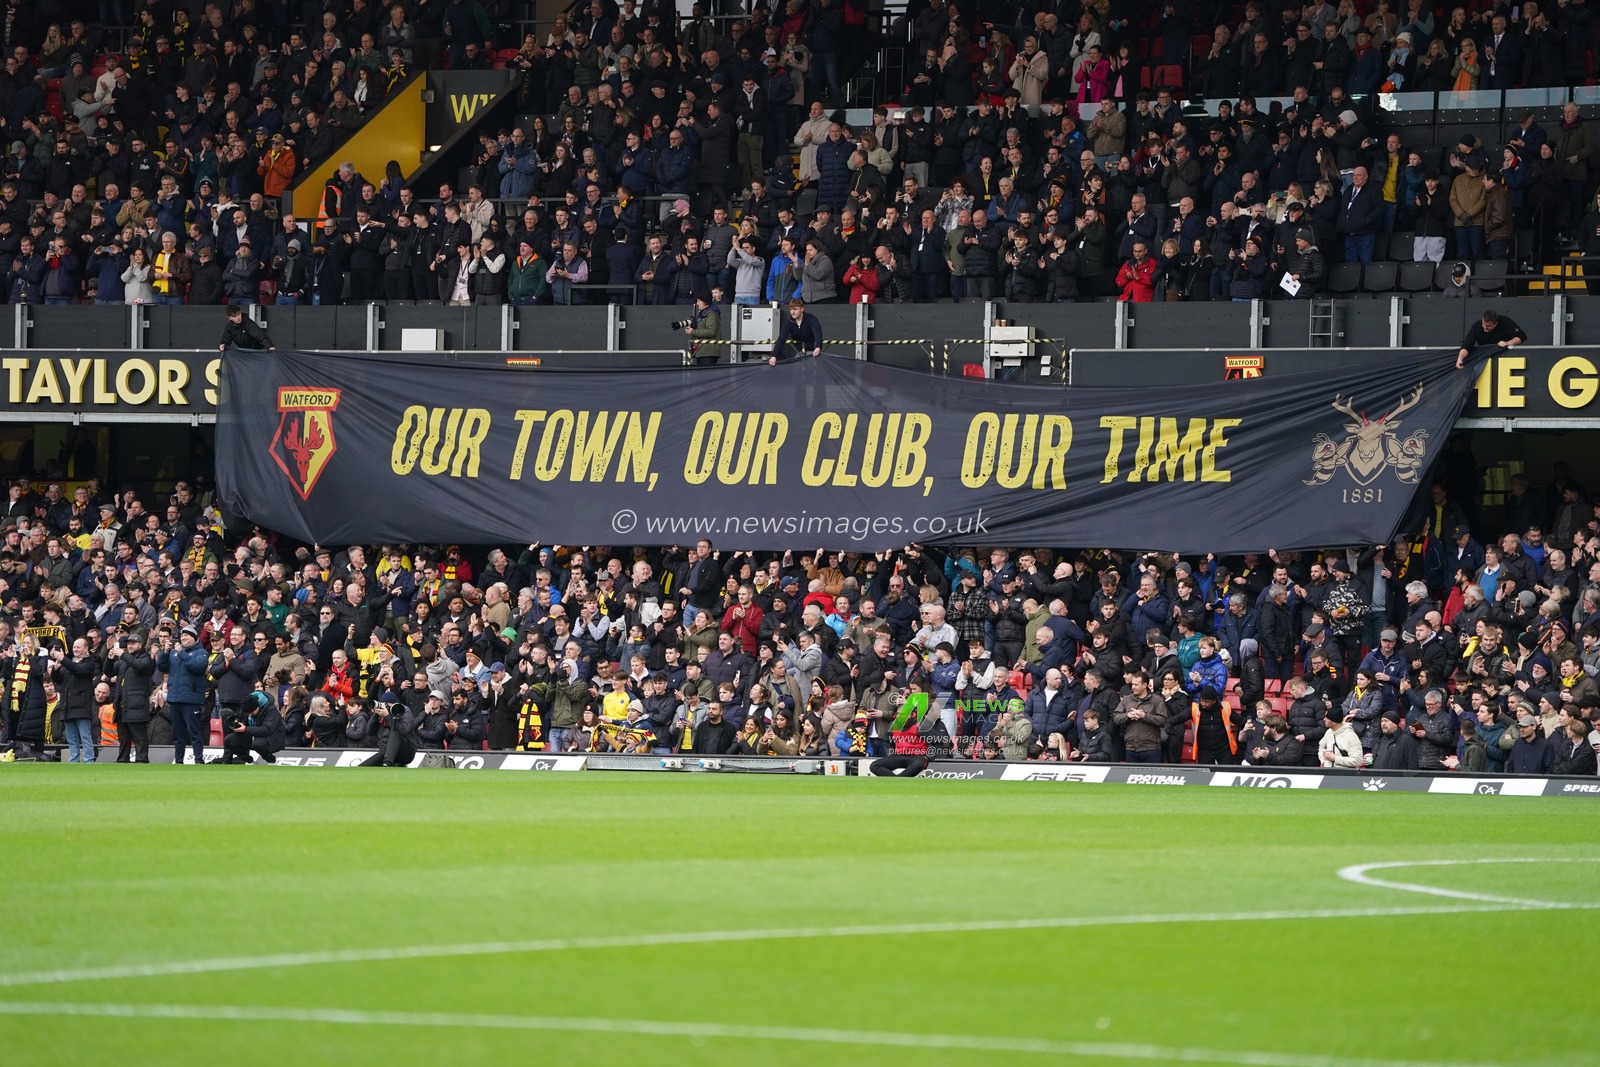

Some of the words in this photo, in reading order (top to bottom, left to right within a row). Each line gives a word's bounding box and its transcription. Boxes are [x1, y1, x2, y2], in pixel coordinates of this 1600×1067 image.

[2, 358, 190, 405] TAYLOR
[284, 393, 332, 405] WATFORD
[391, 405, 491, 478] OUR
[510, 409, 662, 491] TOWN,
[684, 411, 789, 485] OUR
[801, 411, 934, 496] CLUB,
[961, 411, 1073, 490] OUR
[1099, 415, 1242, 483] TIME
[1342, 489, 1382, 503] 1881
[1024, 772, 1086, 782] ASUS
[1128, 774, 1186, 782] FOOTBALL
